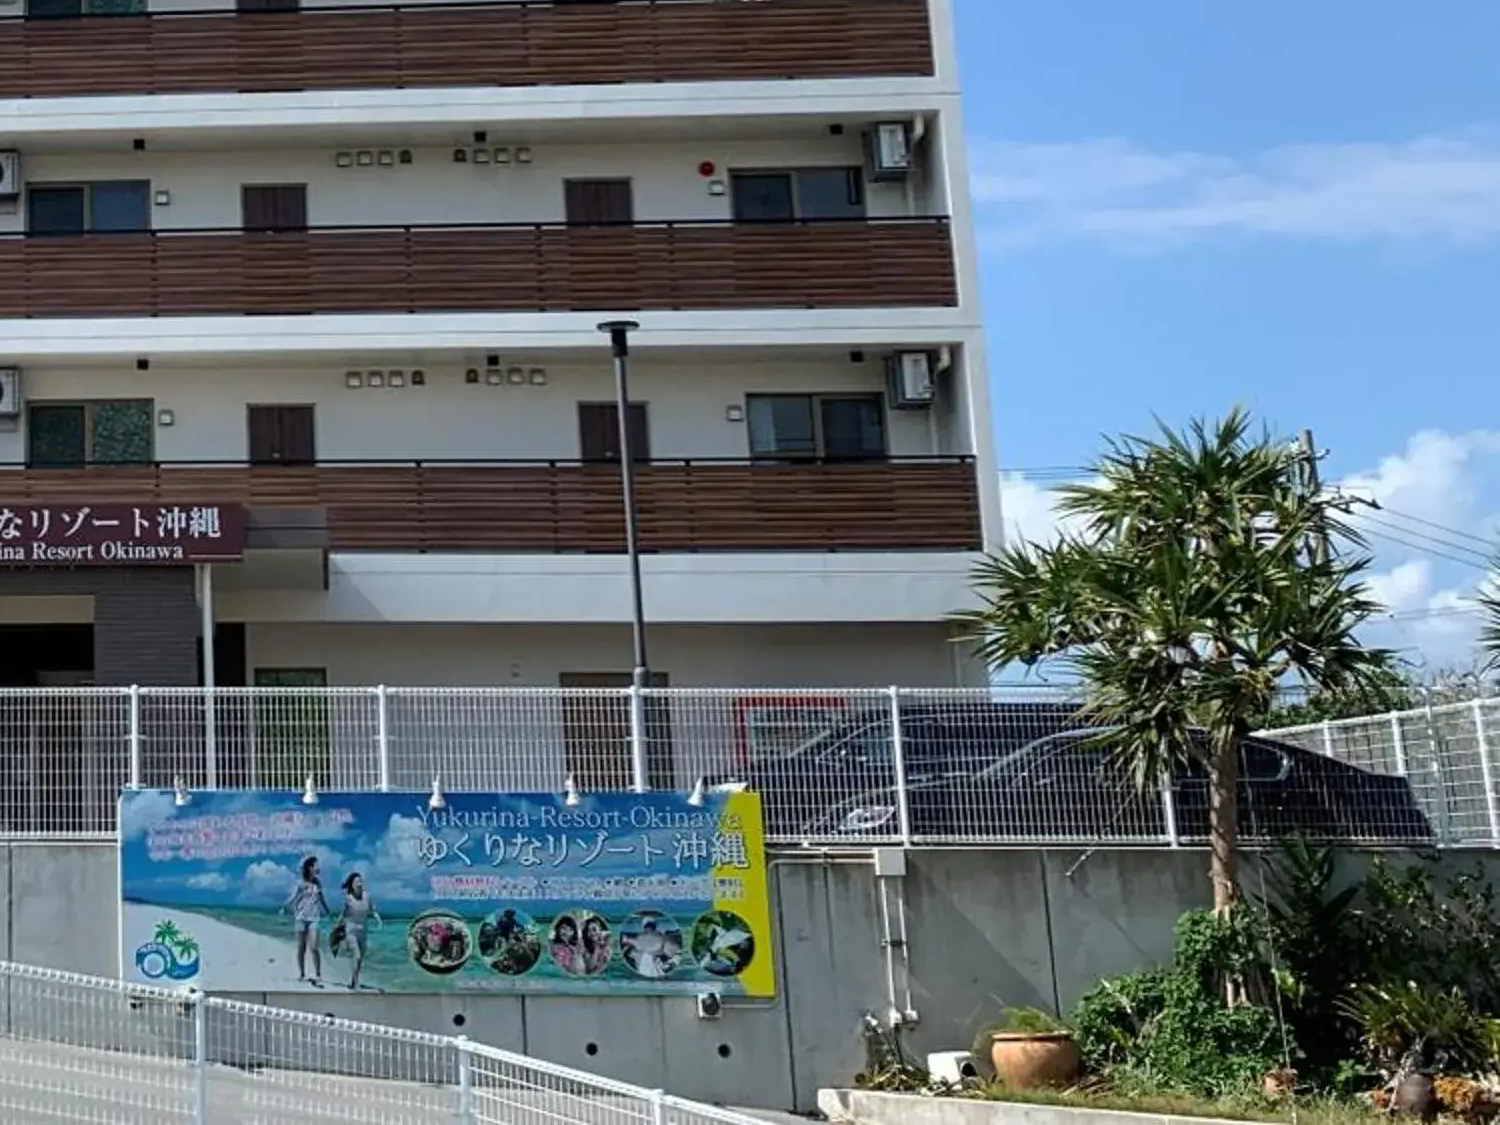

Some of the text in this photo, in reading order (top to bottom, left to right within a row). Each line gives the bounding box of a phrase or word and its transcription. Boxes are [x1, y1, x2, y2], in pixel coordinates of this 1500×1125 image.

[32, 542, 94, 559] Resort
[101, 541, 184, 559] Okinawa
[418, 831, 748, 869] ゆくりなリゾート沖縄
